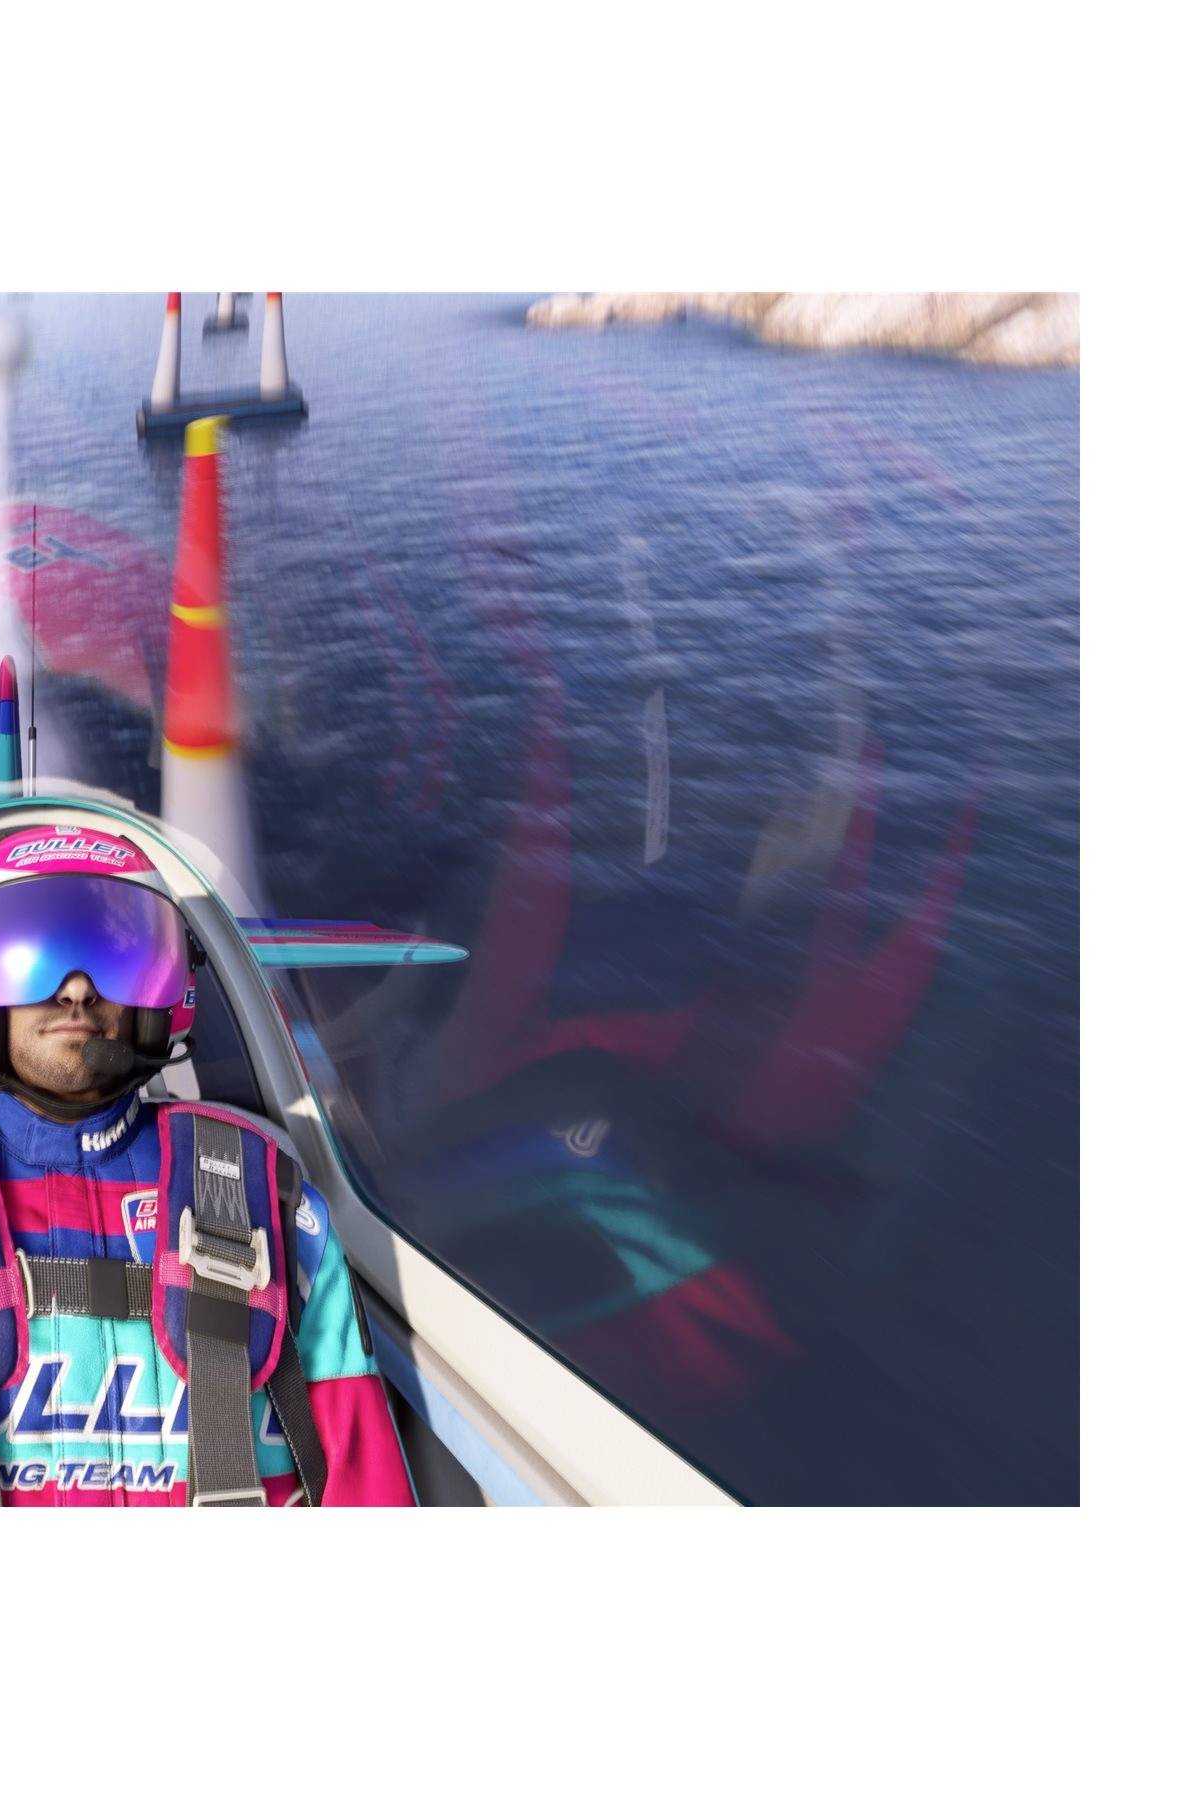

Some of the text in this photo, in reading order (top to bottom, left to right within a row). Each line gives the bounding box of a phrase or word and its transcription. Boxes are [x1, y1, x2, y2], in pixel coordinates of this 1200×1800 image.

[6, 838, 135, 862] BULLET
[134, 1218, 156, 1231] AIR
[57, 1462, 176, 1490] TEAM
